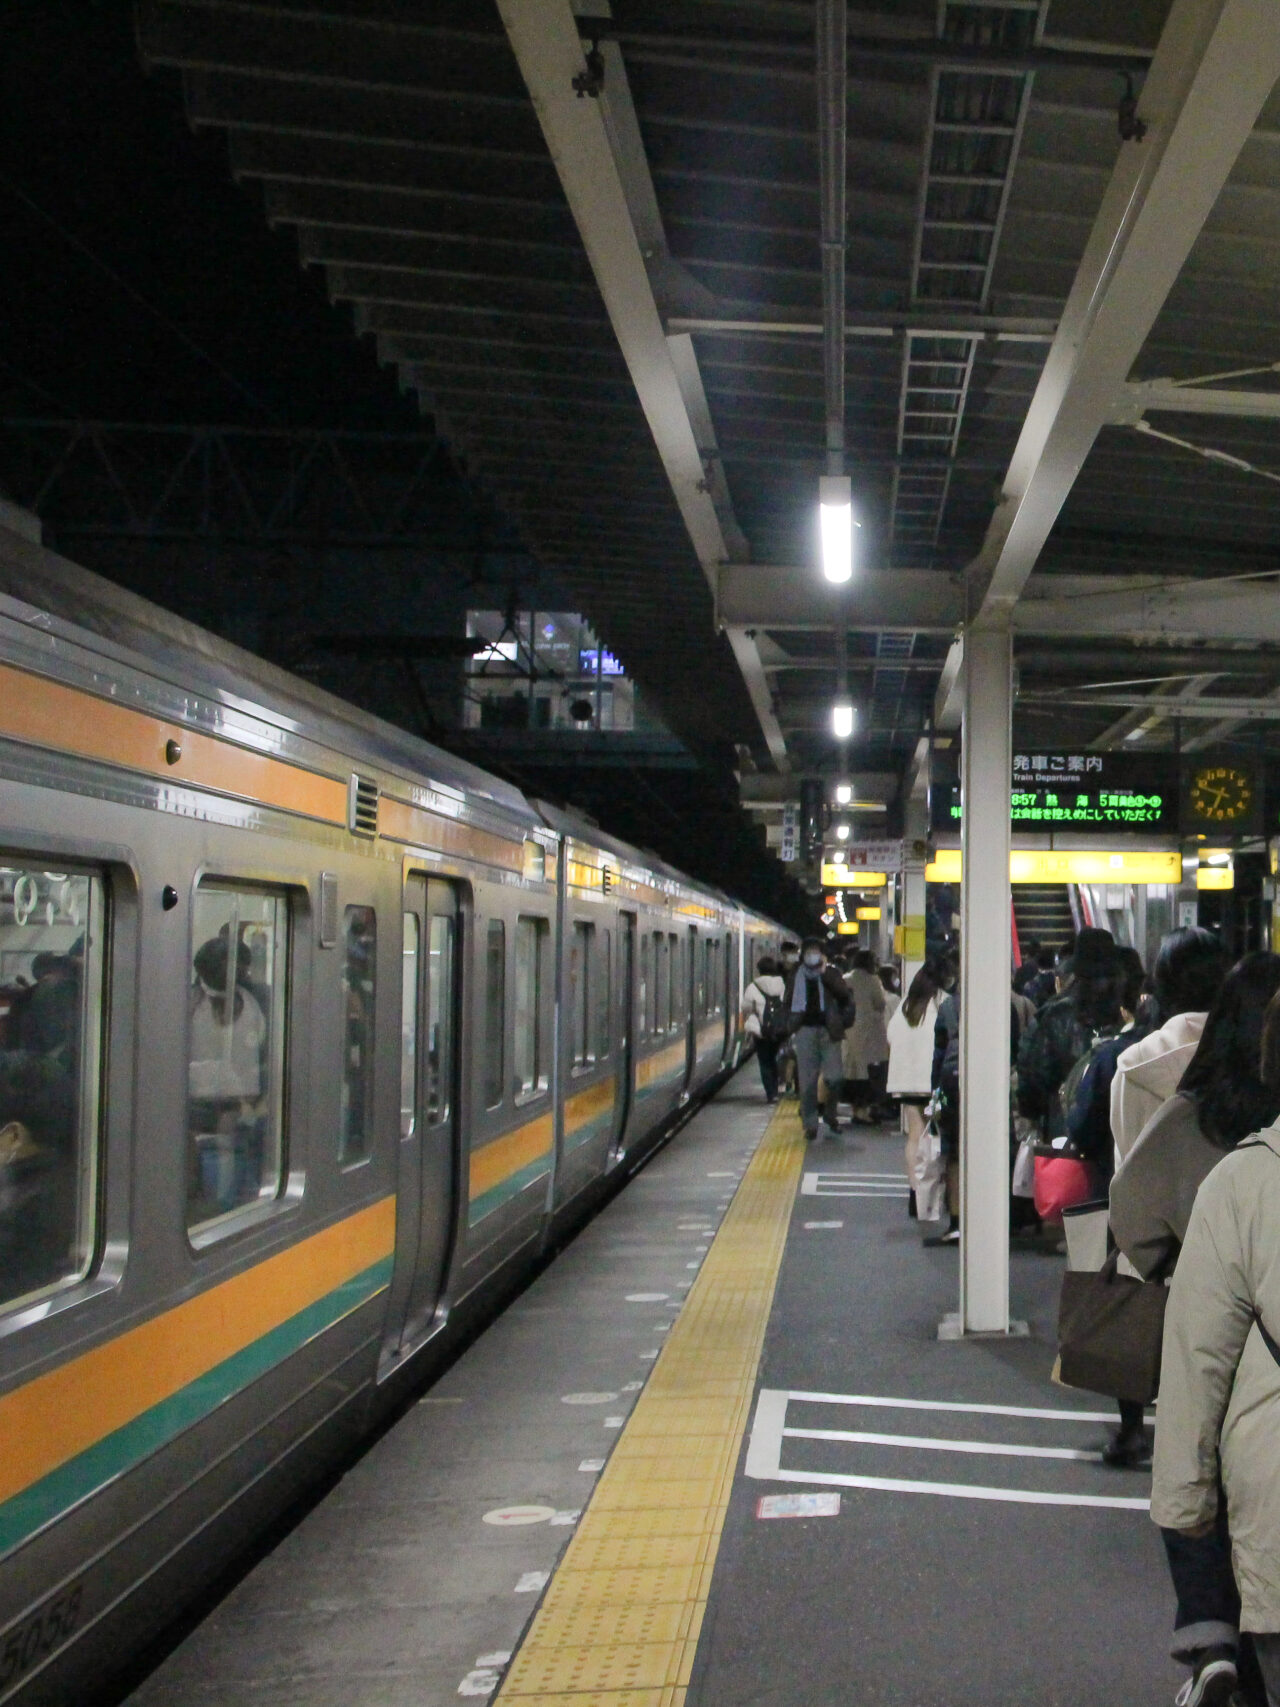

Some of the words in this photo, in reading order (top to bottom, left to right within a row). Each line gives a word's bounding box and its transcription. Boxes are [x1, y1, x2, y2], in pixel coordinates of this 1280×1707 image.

[1013, 755, 1103, 772] 発車ご案内
[1013, 773, 1034, 782] Train
[1035, 773, 1081, 783] Departures
